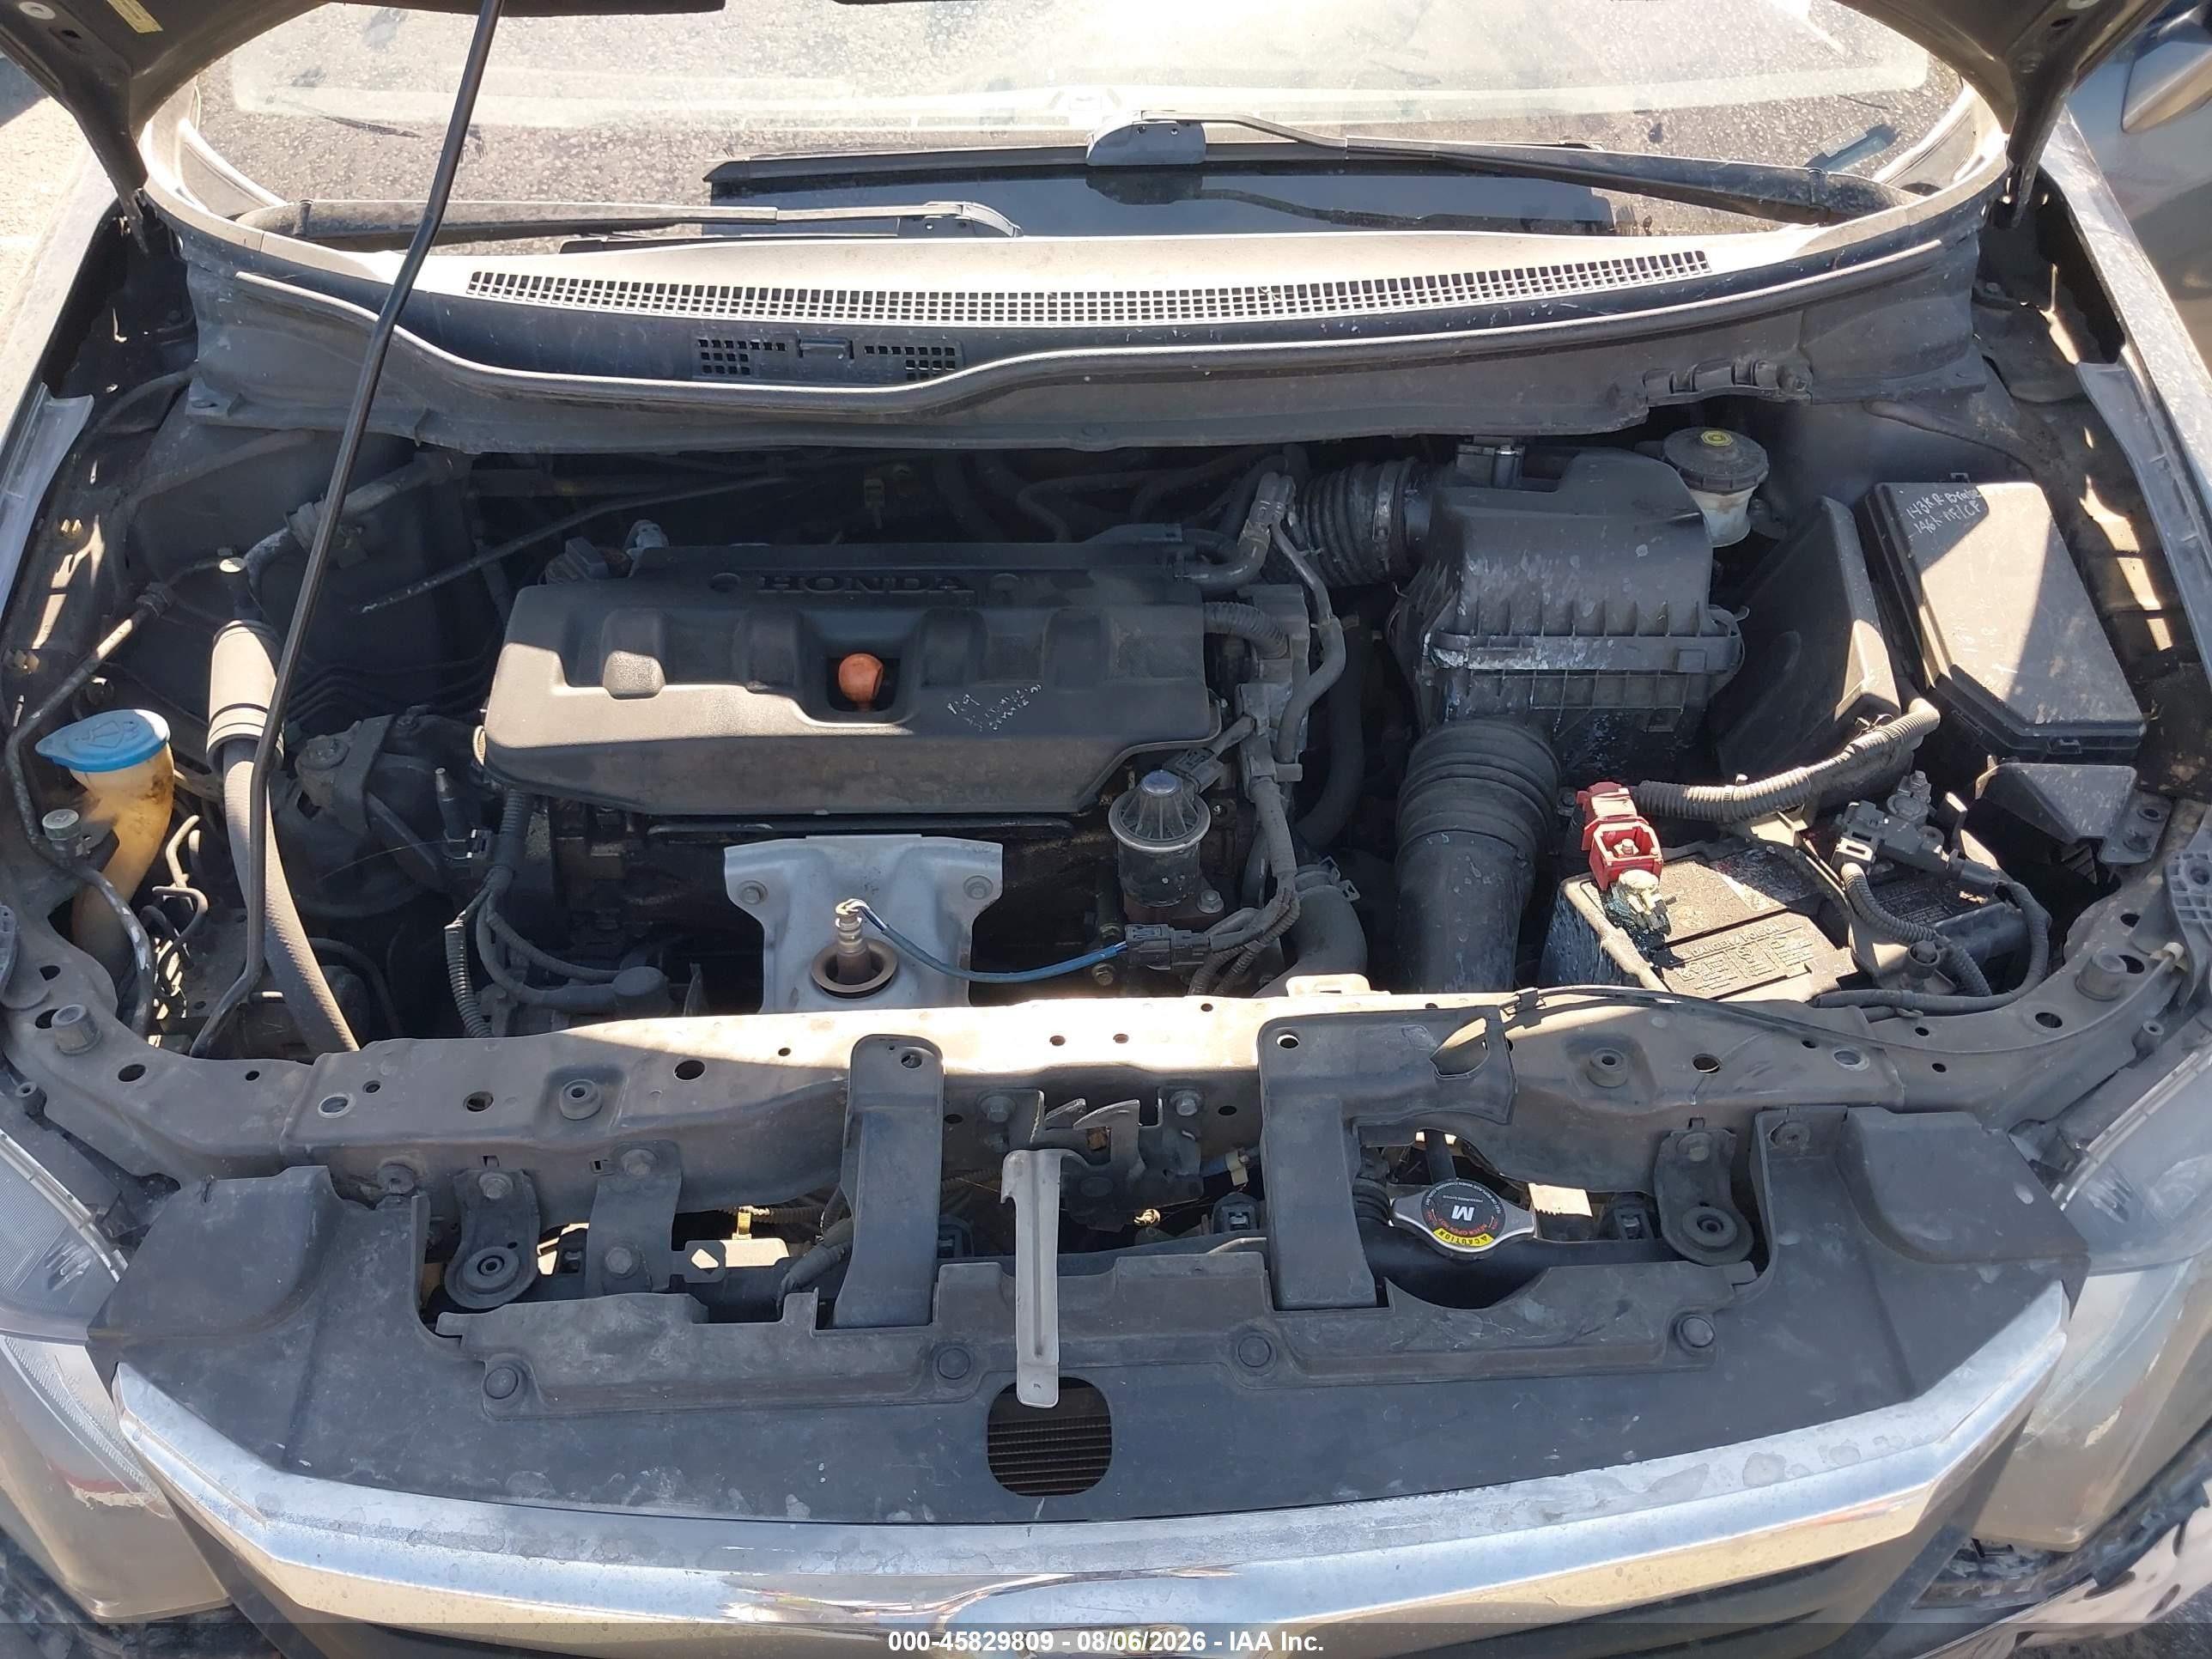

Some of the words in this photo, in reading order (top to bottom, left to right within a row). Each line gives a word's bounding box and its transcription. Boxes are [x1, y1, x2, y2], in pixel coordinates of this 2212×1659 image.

[757, 575, 975, 593] HONDA
[1692, 939, 1735, 957] DANGER
[1451, 1205, 1475, 1221] M
[1438, 1230, 1480, 1244] CAUTION
